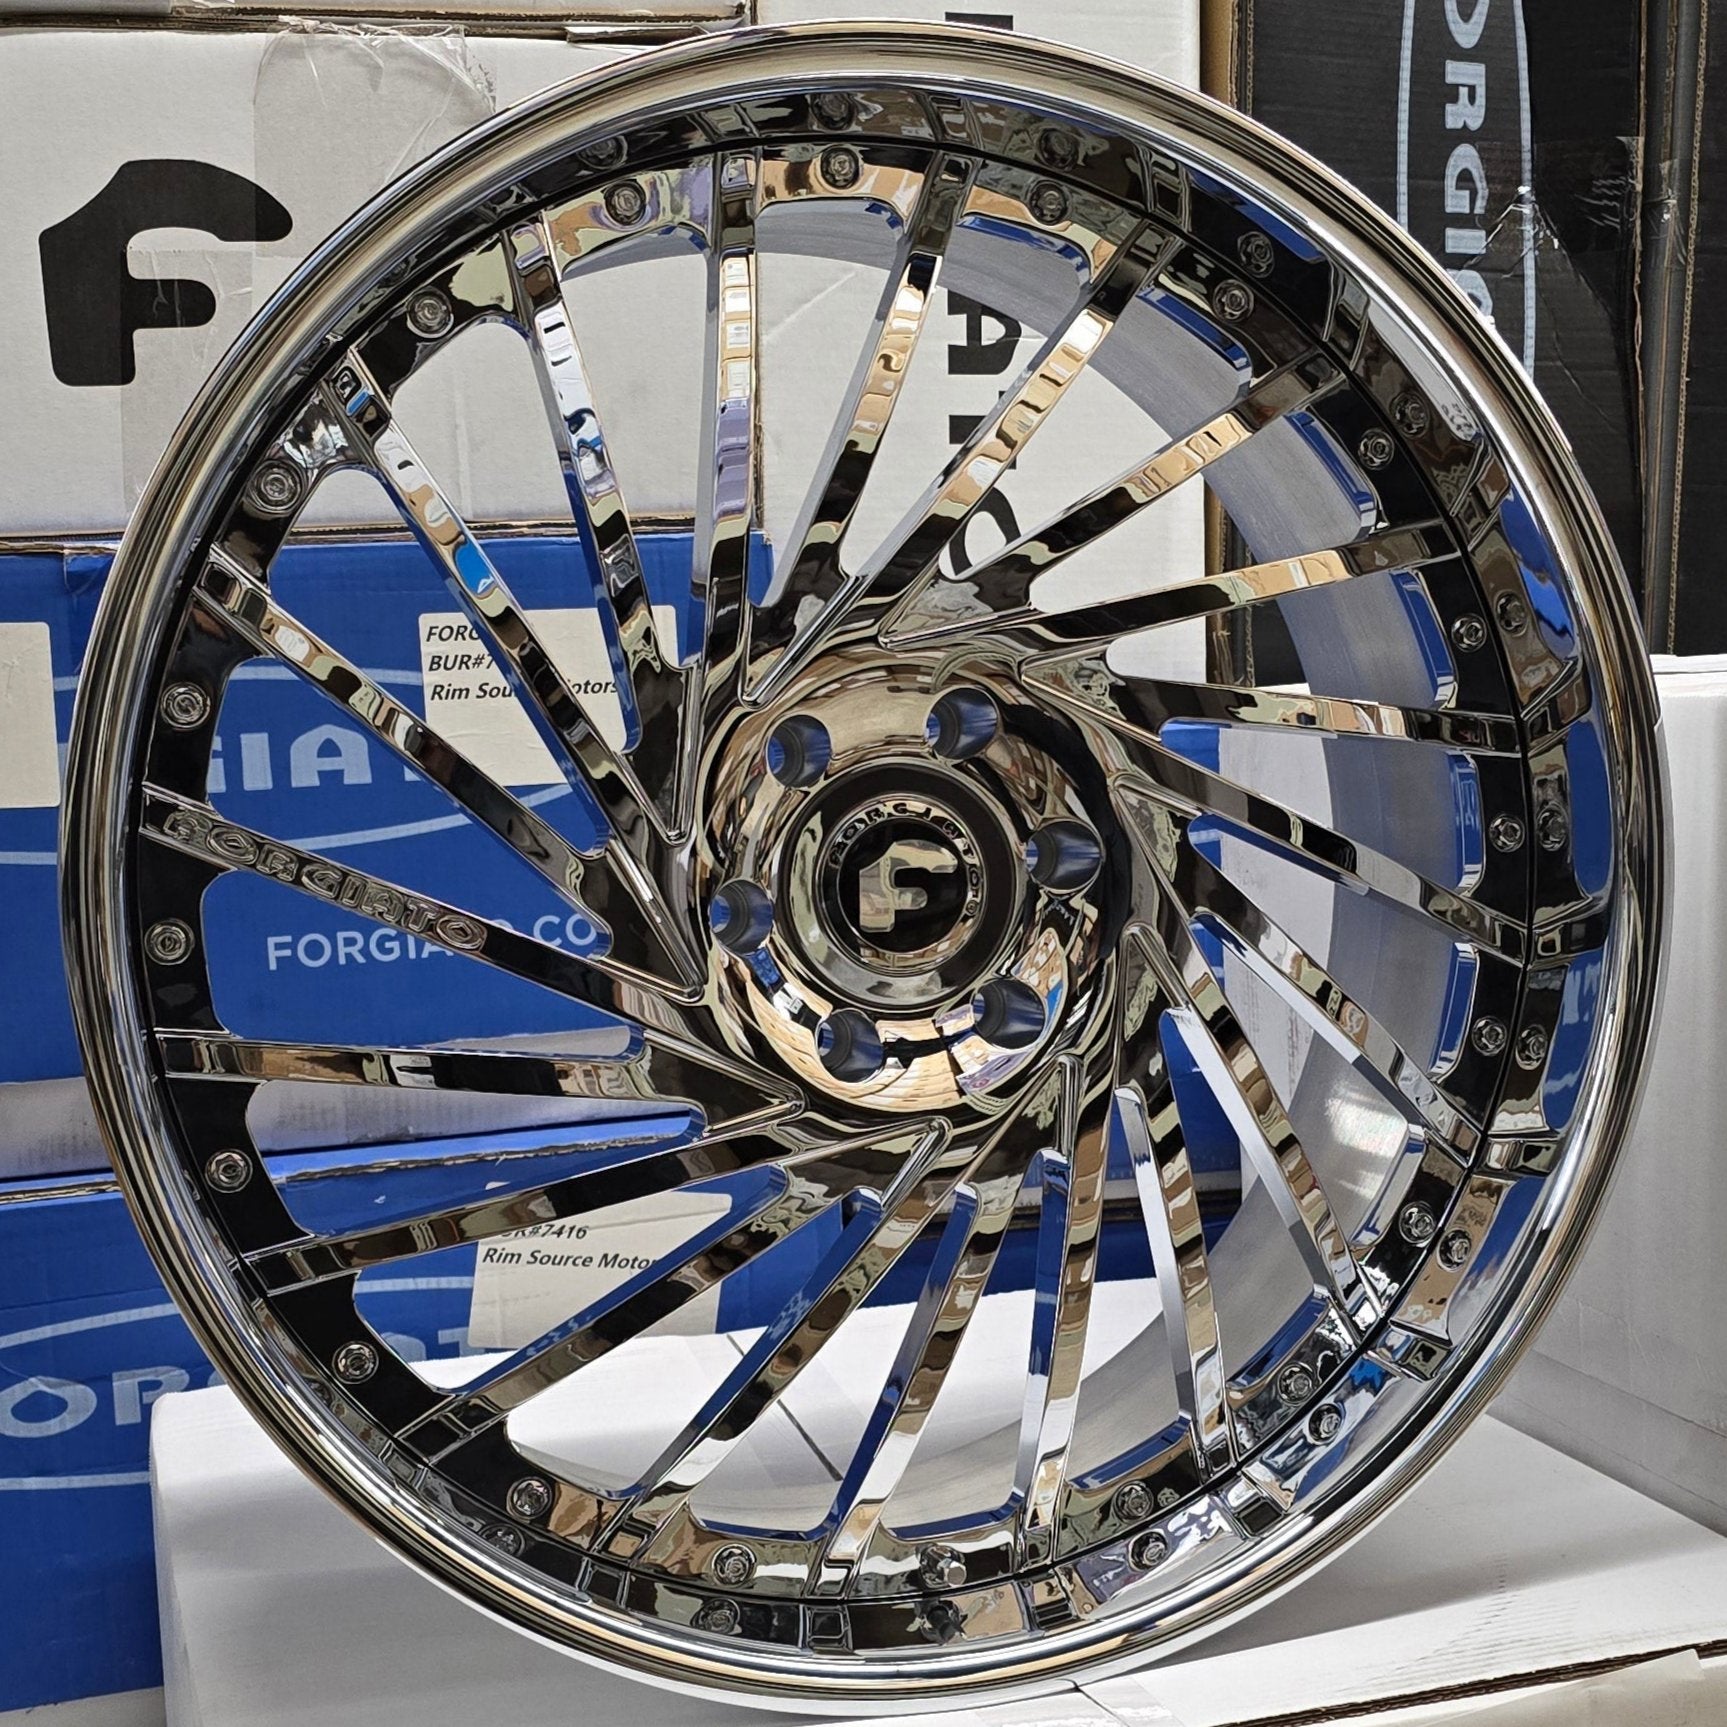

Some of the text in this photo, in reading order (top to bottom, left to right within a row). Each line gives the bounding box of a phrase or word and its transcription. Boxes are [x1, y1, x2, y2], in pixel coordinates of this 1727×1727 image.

[430, 683, 470, 700] Rim
[163, 808, 488, 951] FORGIATO
[482, 1247, 522, 1263] Rim
[526, 1249, 594, 1268] Source
